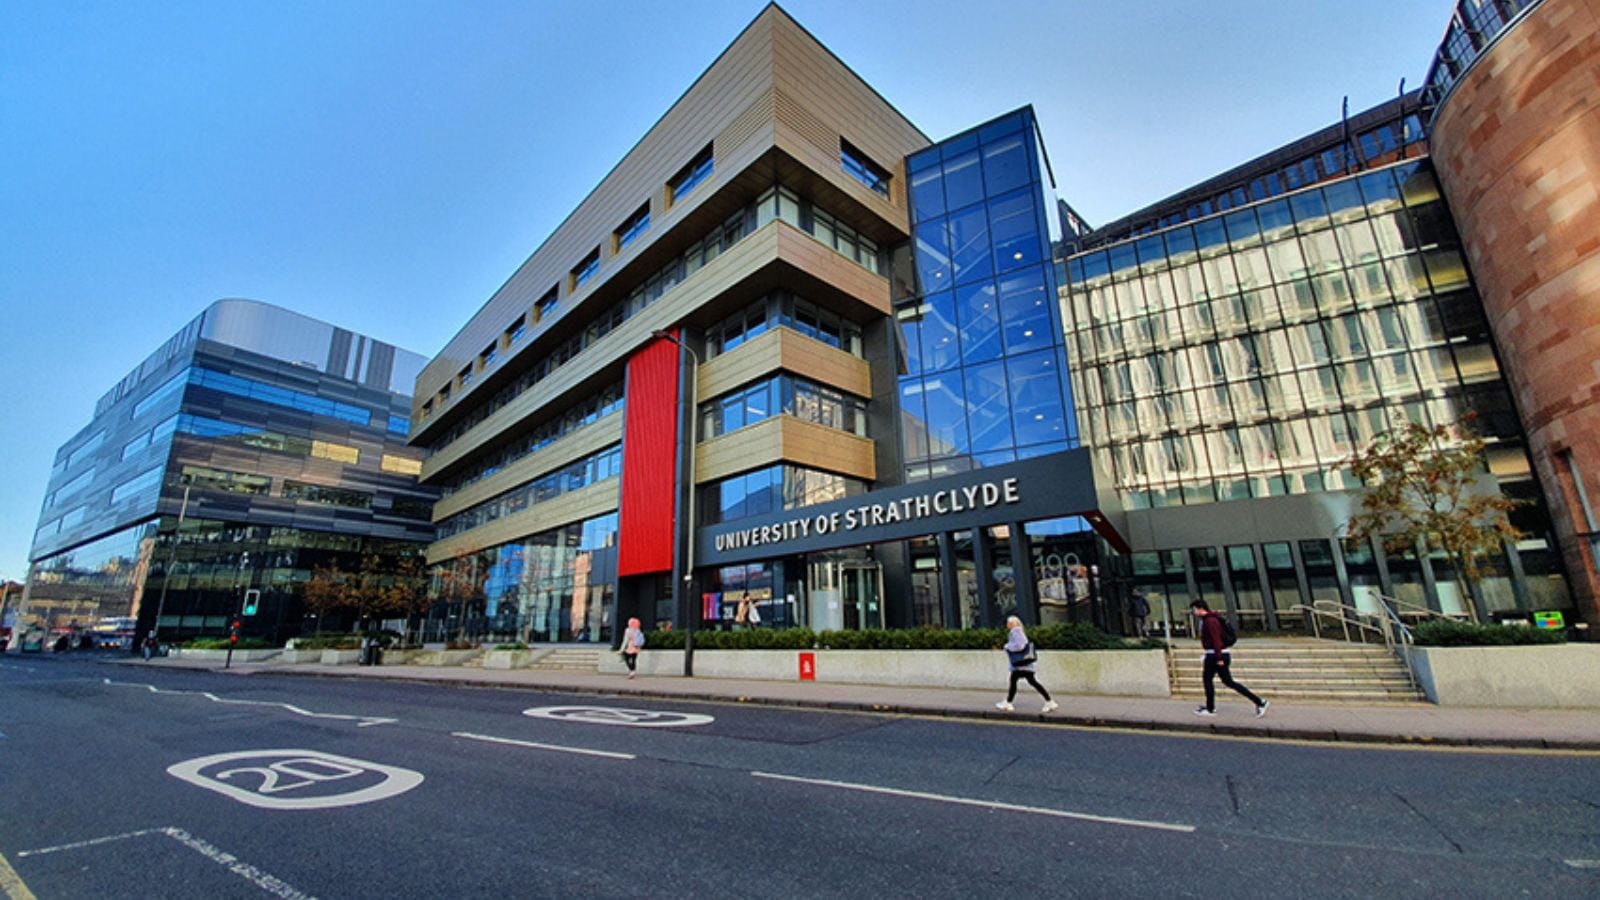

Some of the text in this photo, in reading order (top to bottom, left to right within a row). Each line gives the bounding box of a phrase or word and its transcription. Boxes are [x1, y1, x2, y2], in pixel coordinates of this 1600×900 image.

[714, 477, 1020, 552] UNIVERSITY OF STRATHCLYDE
[215, 757, 365, 793] 20
